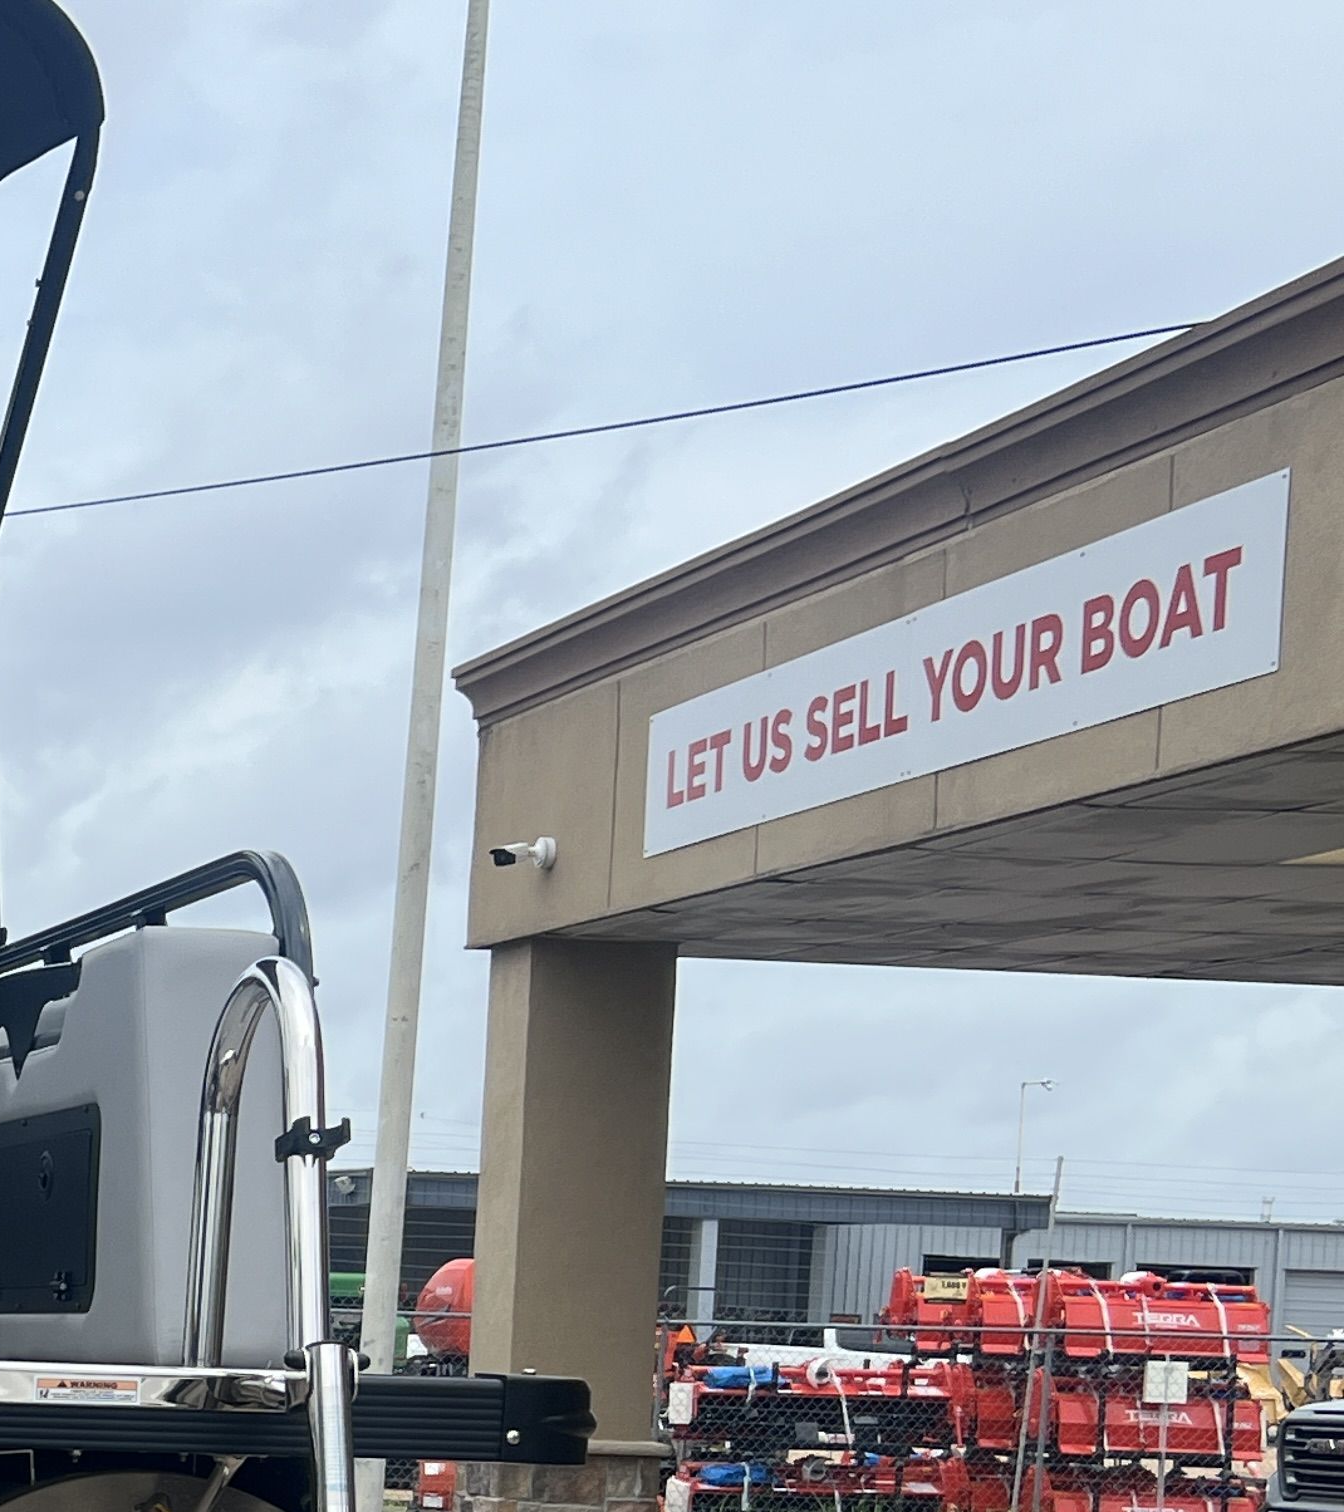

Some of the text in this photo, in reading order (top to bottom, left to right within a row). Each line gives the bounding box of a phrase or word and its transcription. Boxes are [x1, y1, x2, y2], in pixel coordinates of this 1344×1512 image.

[666, 546, 1243, 807] LET US SELL YOUR BOAT
